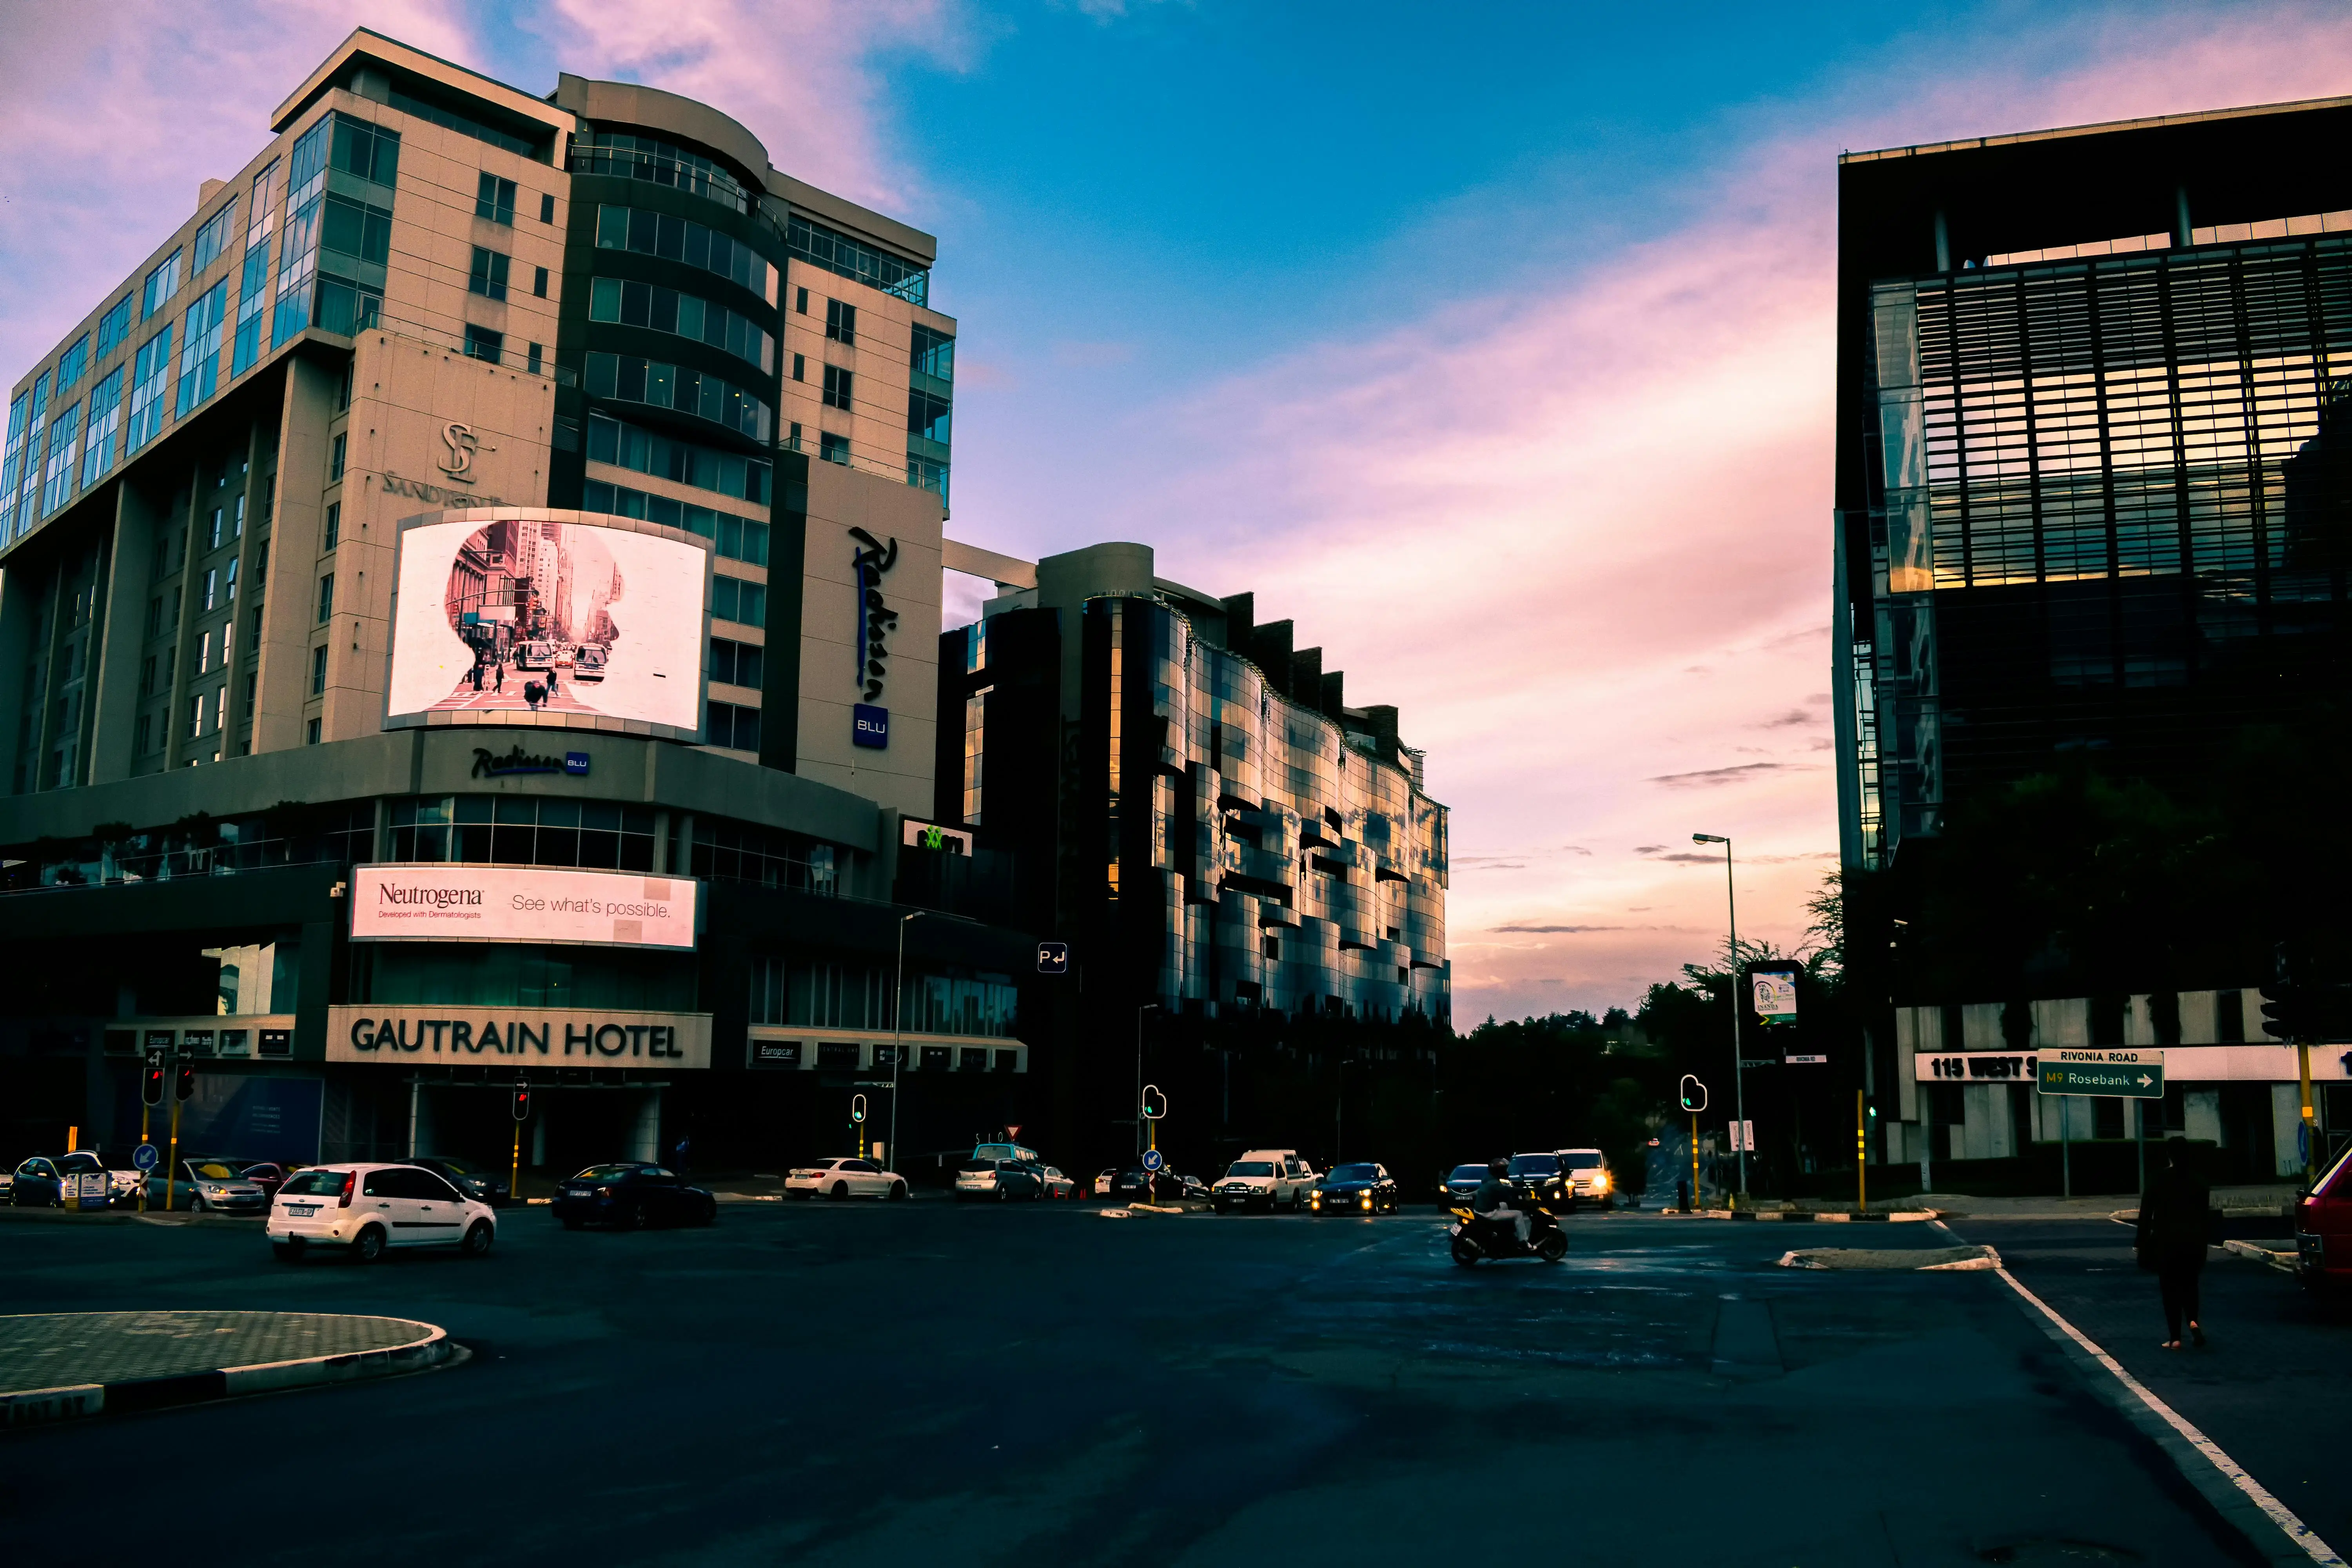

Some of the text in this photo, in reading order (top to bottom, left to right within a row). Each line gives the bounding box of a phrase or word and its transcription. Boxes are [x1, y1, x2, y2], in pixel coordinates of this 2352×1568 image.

[858, 720, 885, 733] BLU
[379, 883, 483, 909] Neutrogena
[512, 895, 670, 917] See what's possible.
[428, 911, 481, 920] Dermatologists
[1040, 951, 1051, 964] P
[351, 1018, 683, 1058] GAUTRAIN HOTEL
[761, 1045, 794, 1056] Europcar
[2061, 1051, 2138, 1062] RIVONIA ROAD
[1931, 1057, 1964, 1077] 115
[1967, 1056, 2023, 1077] WEST
[2046, 1072, 2130, 1085] M9 Rosebank
